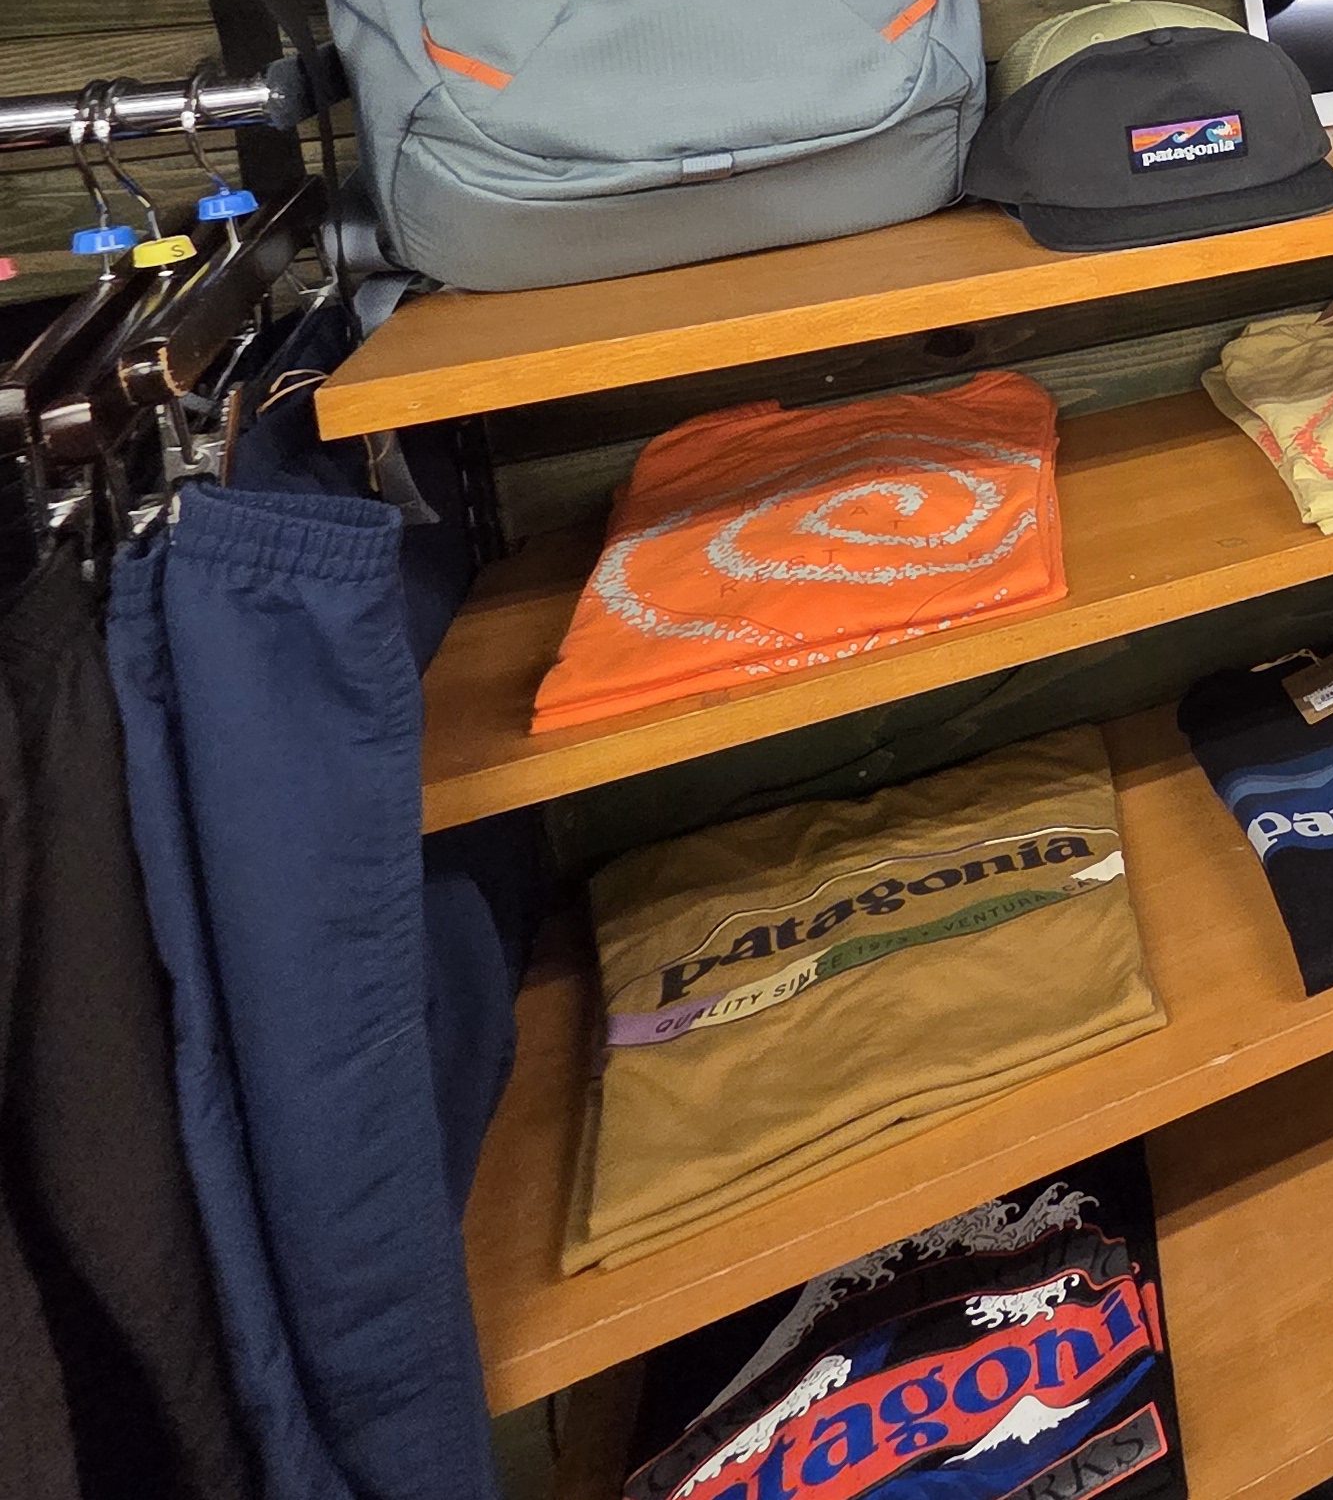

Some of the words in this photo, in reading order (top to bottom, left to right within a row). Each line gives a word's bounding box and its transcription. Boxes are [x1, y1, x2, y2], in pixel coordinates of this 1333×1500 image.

[1141, 139, 1238, 167] patagonia
[209, 197, 233, 216] LL
[94, 228, 119, 250] LL
[171, 243, 186, 258] S
[658, 834, 1094, 1008] patagonia
[655, 992, 762, 1036] QUALITY
[774, 954, 844, 998] SINCE
[942, 893, 1047, 933] VENTURA
[705, 1288, 1150, 1500] tagoni
